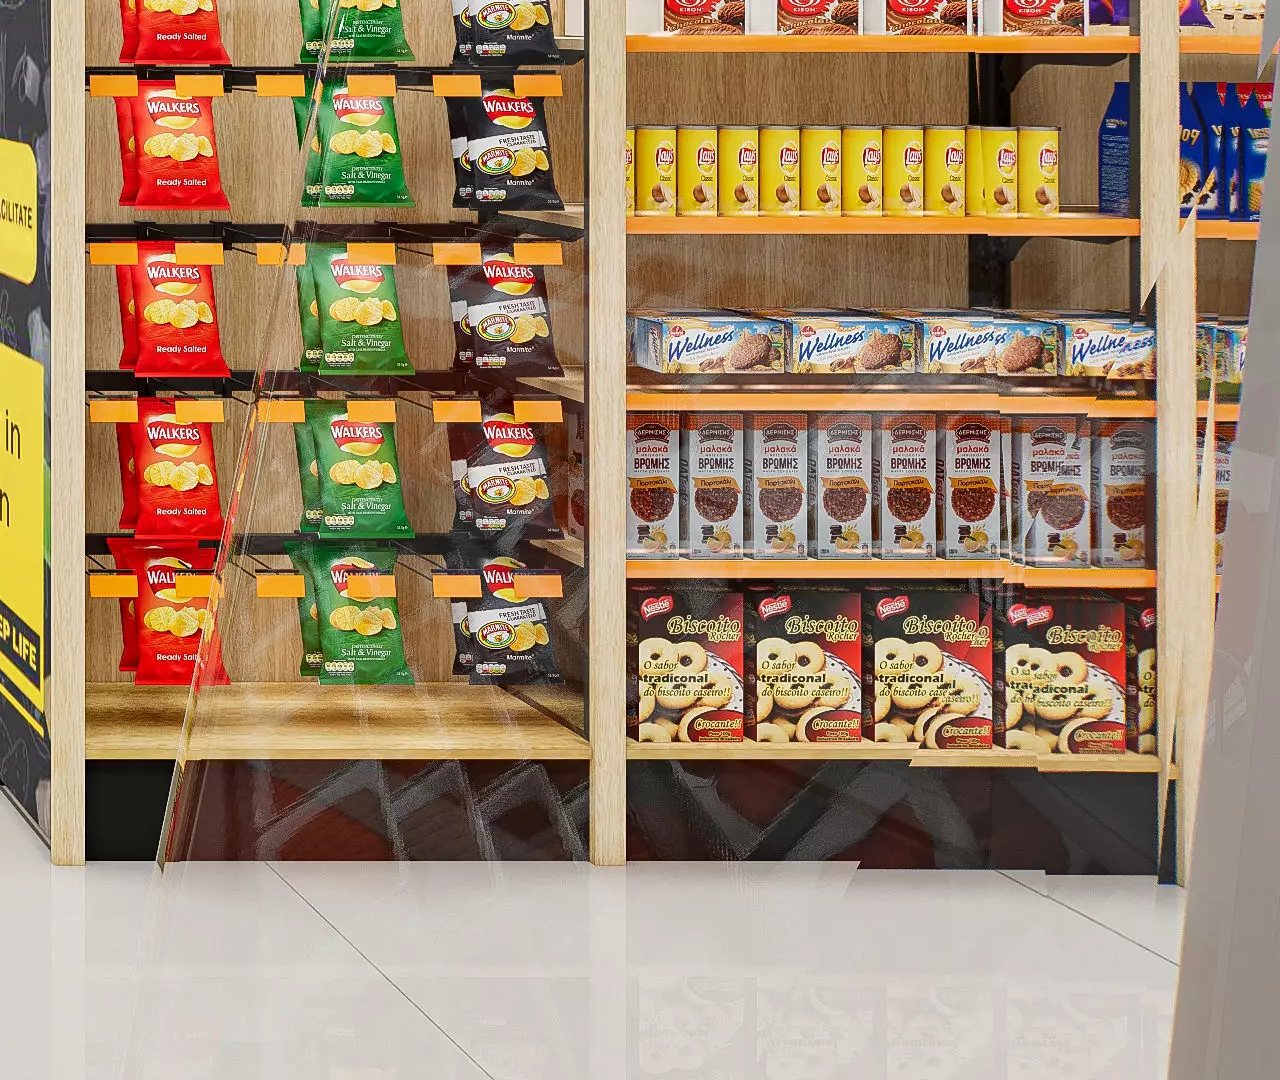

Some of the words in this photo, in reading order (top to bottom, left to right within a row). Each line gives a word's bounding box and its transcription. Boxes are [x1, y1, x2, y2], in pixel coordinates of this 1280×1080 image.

[482, 4, 509, 17] MARMITE
[156, 32, 180, 42] Ready
[182, 32, 207, 41] Salted
[148, 100, 200, 114] WALKERS
[332, 98, 383, 111] WALKERS
[483, 100, 534, 114] WALKERS
[482, 149, 509, 162] MARMITE
[156, 178, 180, 188] Ready
[182, 178, 207, 187] Salted
[341, 171, 356, 180] Salt
[357, 171, 365, 179] &
[366, 171, 392, 182] Vinegar
[148, 265, 200, 279] WALKERS
[332, 264, 383, 277] WALKERS
[482, 316, 509, 329] MARMITE
[341, 339, 356, 348] Salt
[357, 339, 365, 347] &
[366, 339, 392, 350] Vinegar
[668, 328, 735, 363] Wellness
[799, 328, 866, 363] Wellness
[5, 409, 21, 460] in
[332, 426, 383, 439] WALKERS
[483, 426, 534, 440] WALKERS
[498, 465, 518, 473] FRESH
[156, 507, 180, 517] Ready
[182, 507, 207, 516] Salted
[667, 614, 741, 635] Biscoito
[785, 614, 859, 635] Biscoito
[708, 631, 742, 643] Rocher
[826, 631, 860, 643] Rocher
[11, 622, 37, 670] LIFE
[643, 661, 653, 670] O
[655, 660, 679, 670] sabor
[643, 673, 709, 683] tradiconal
[761, 673, 827, 683] tradiconal
[643, 687, 655, 697] do
[657, 686, 691, 697] biscoito
[693, 686, 731, 697] caseiro!!
[694, 718, 742, 731] Crocante!!
[812, 718, 860, 731] Crocante!!
